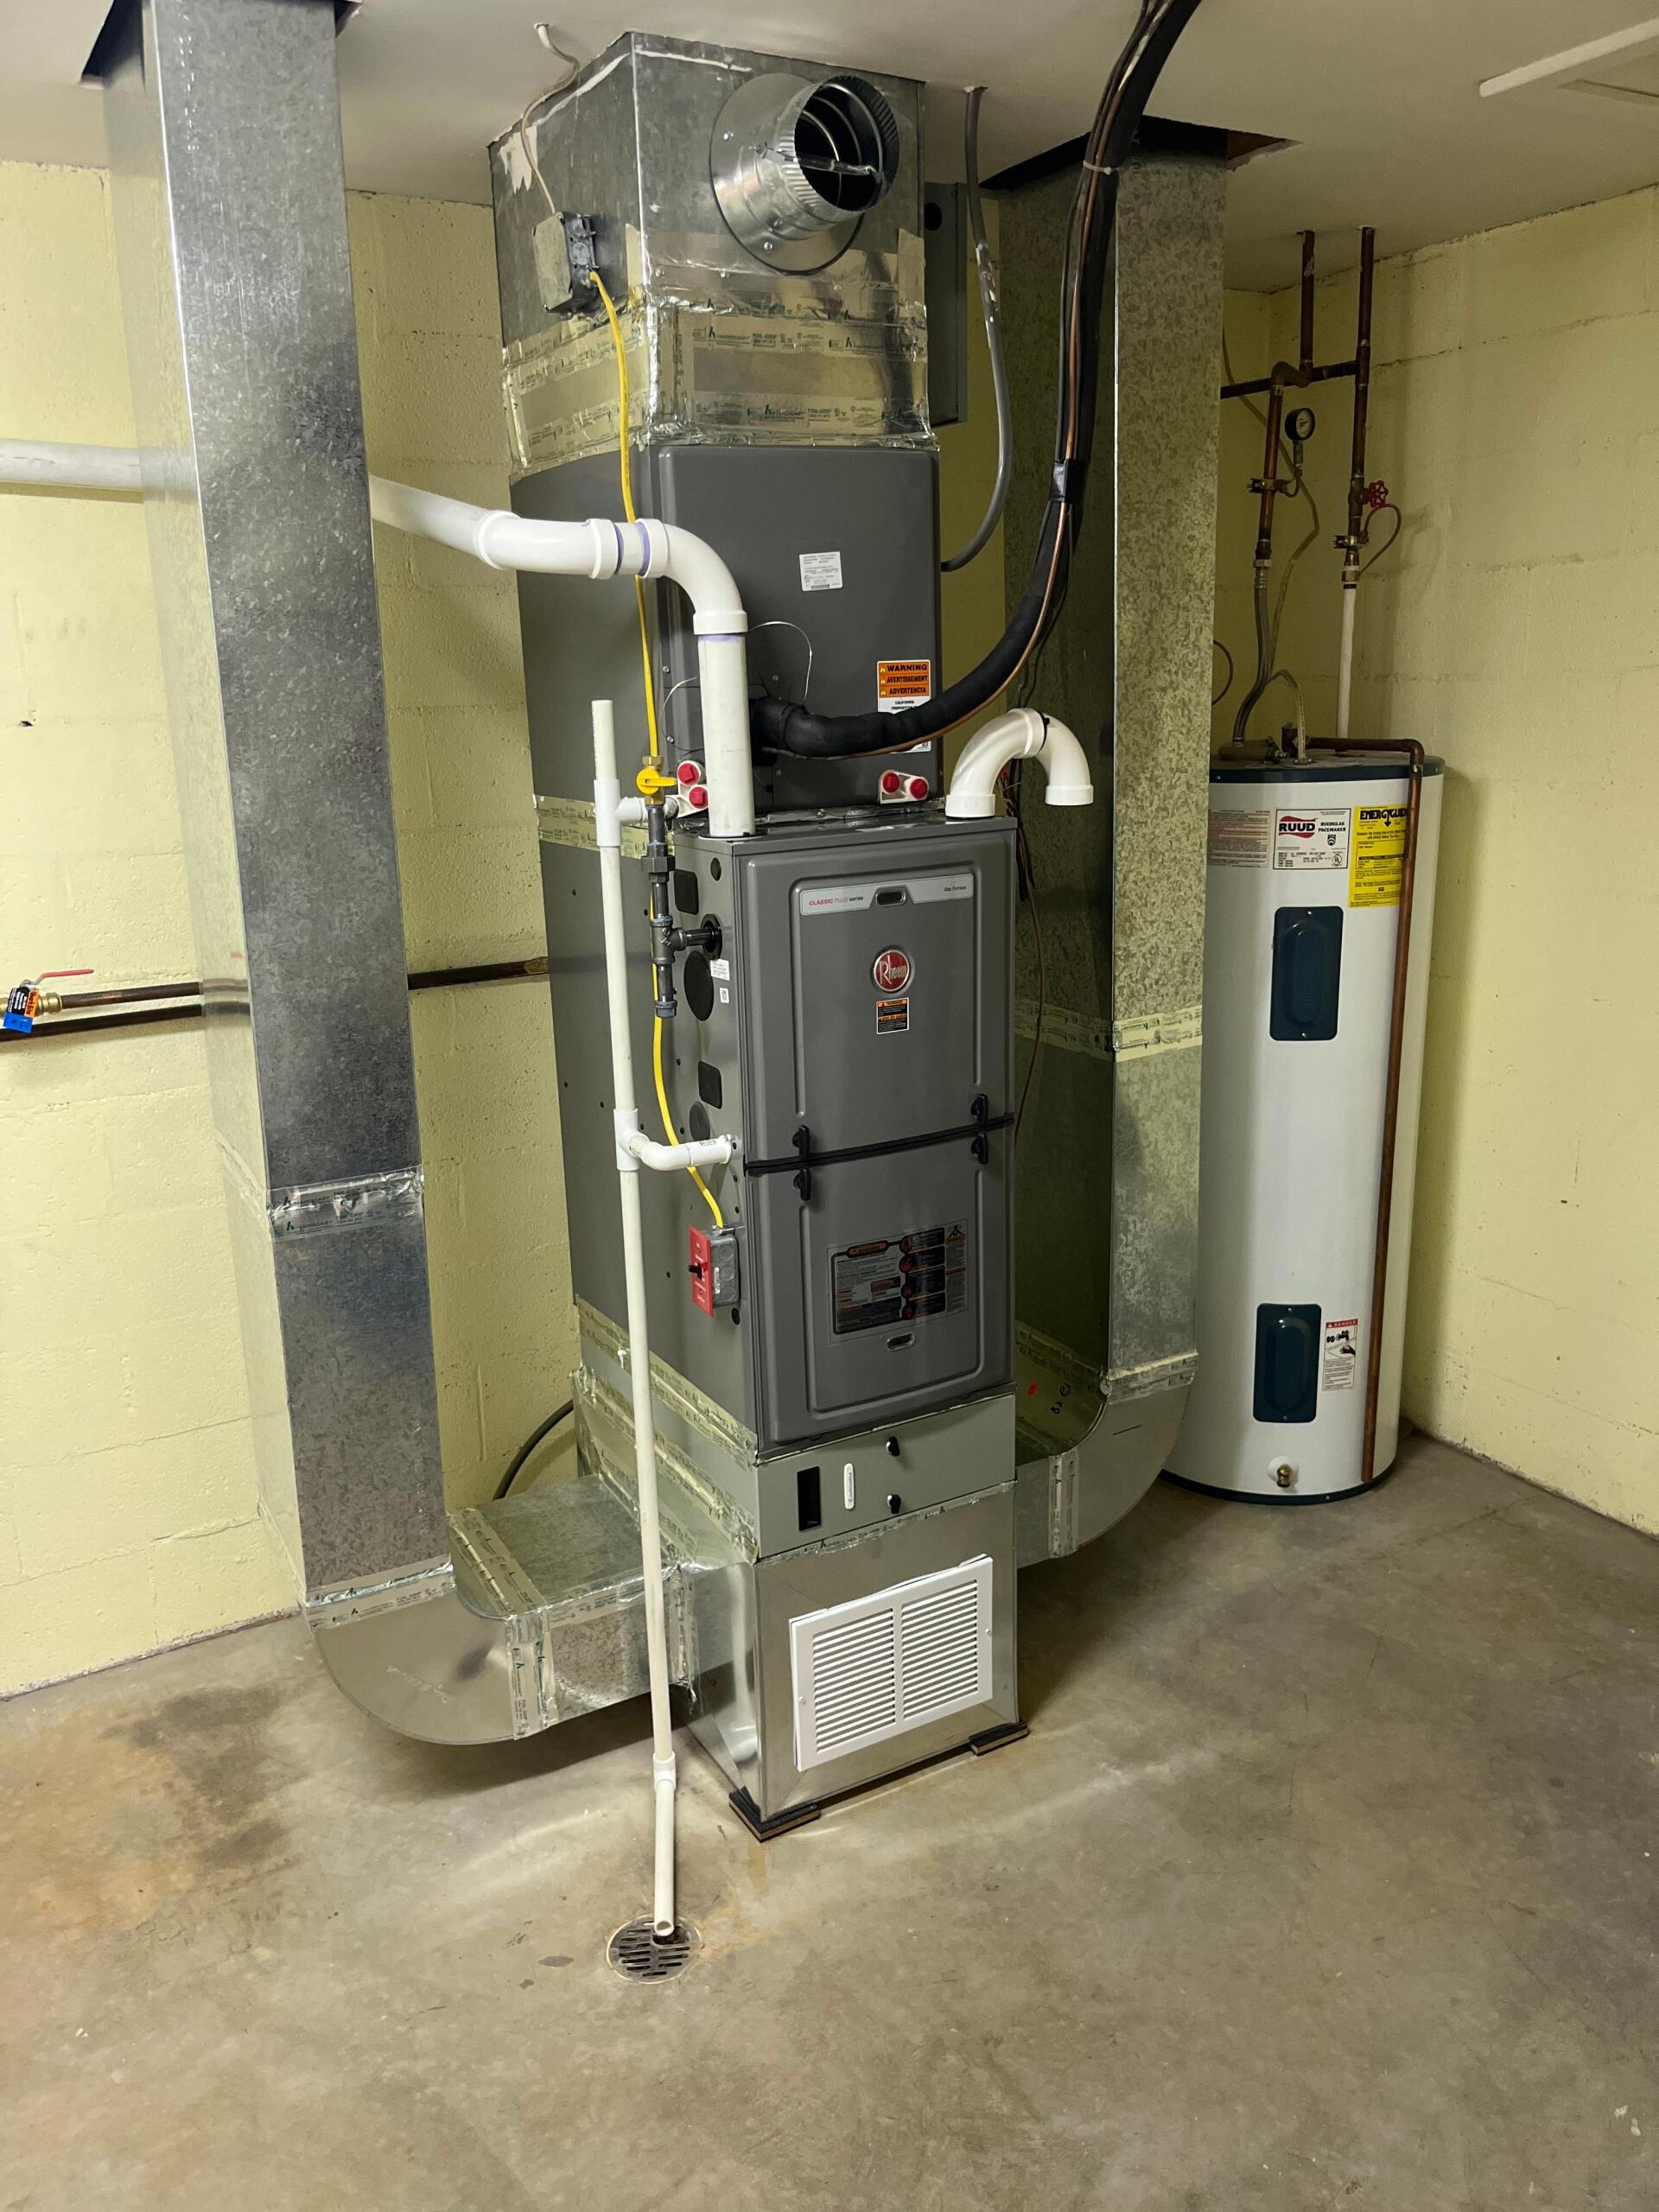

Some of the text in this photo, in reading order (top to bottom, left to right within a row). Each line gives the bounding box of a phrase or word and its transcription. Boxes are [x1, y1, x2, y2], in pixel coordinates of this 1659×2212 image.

[1279, 823, 1315, 831] RUUD
[809, 898, 834, 906] CLASSIC
[880, 955, 907, 985] Rheem
